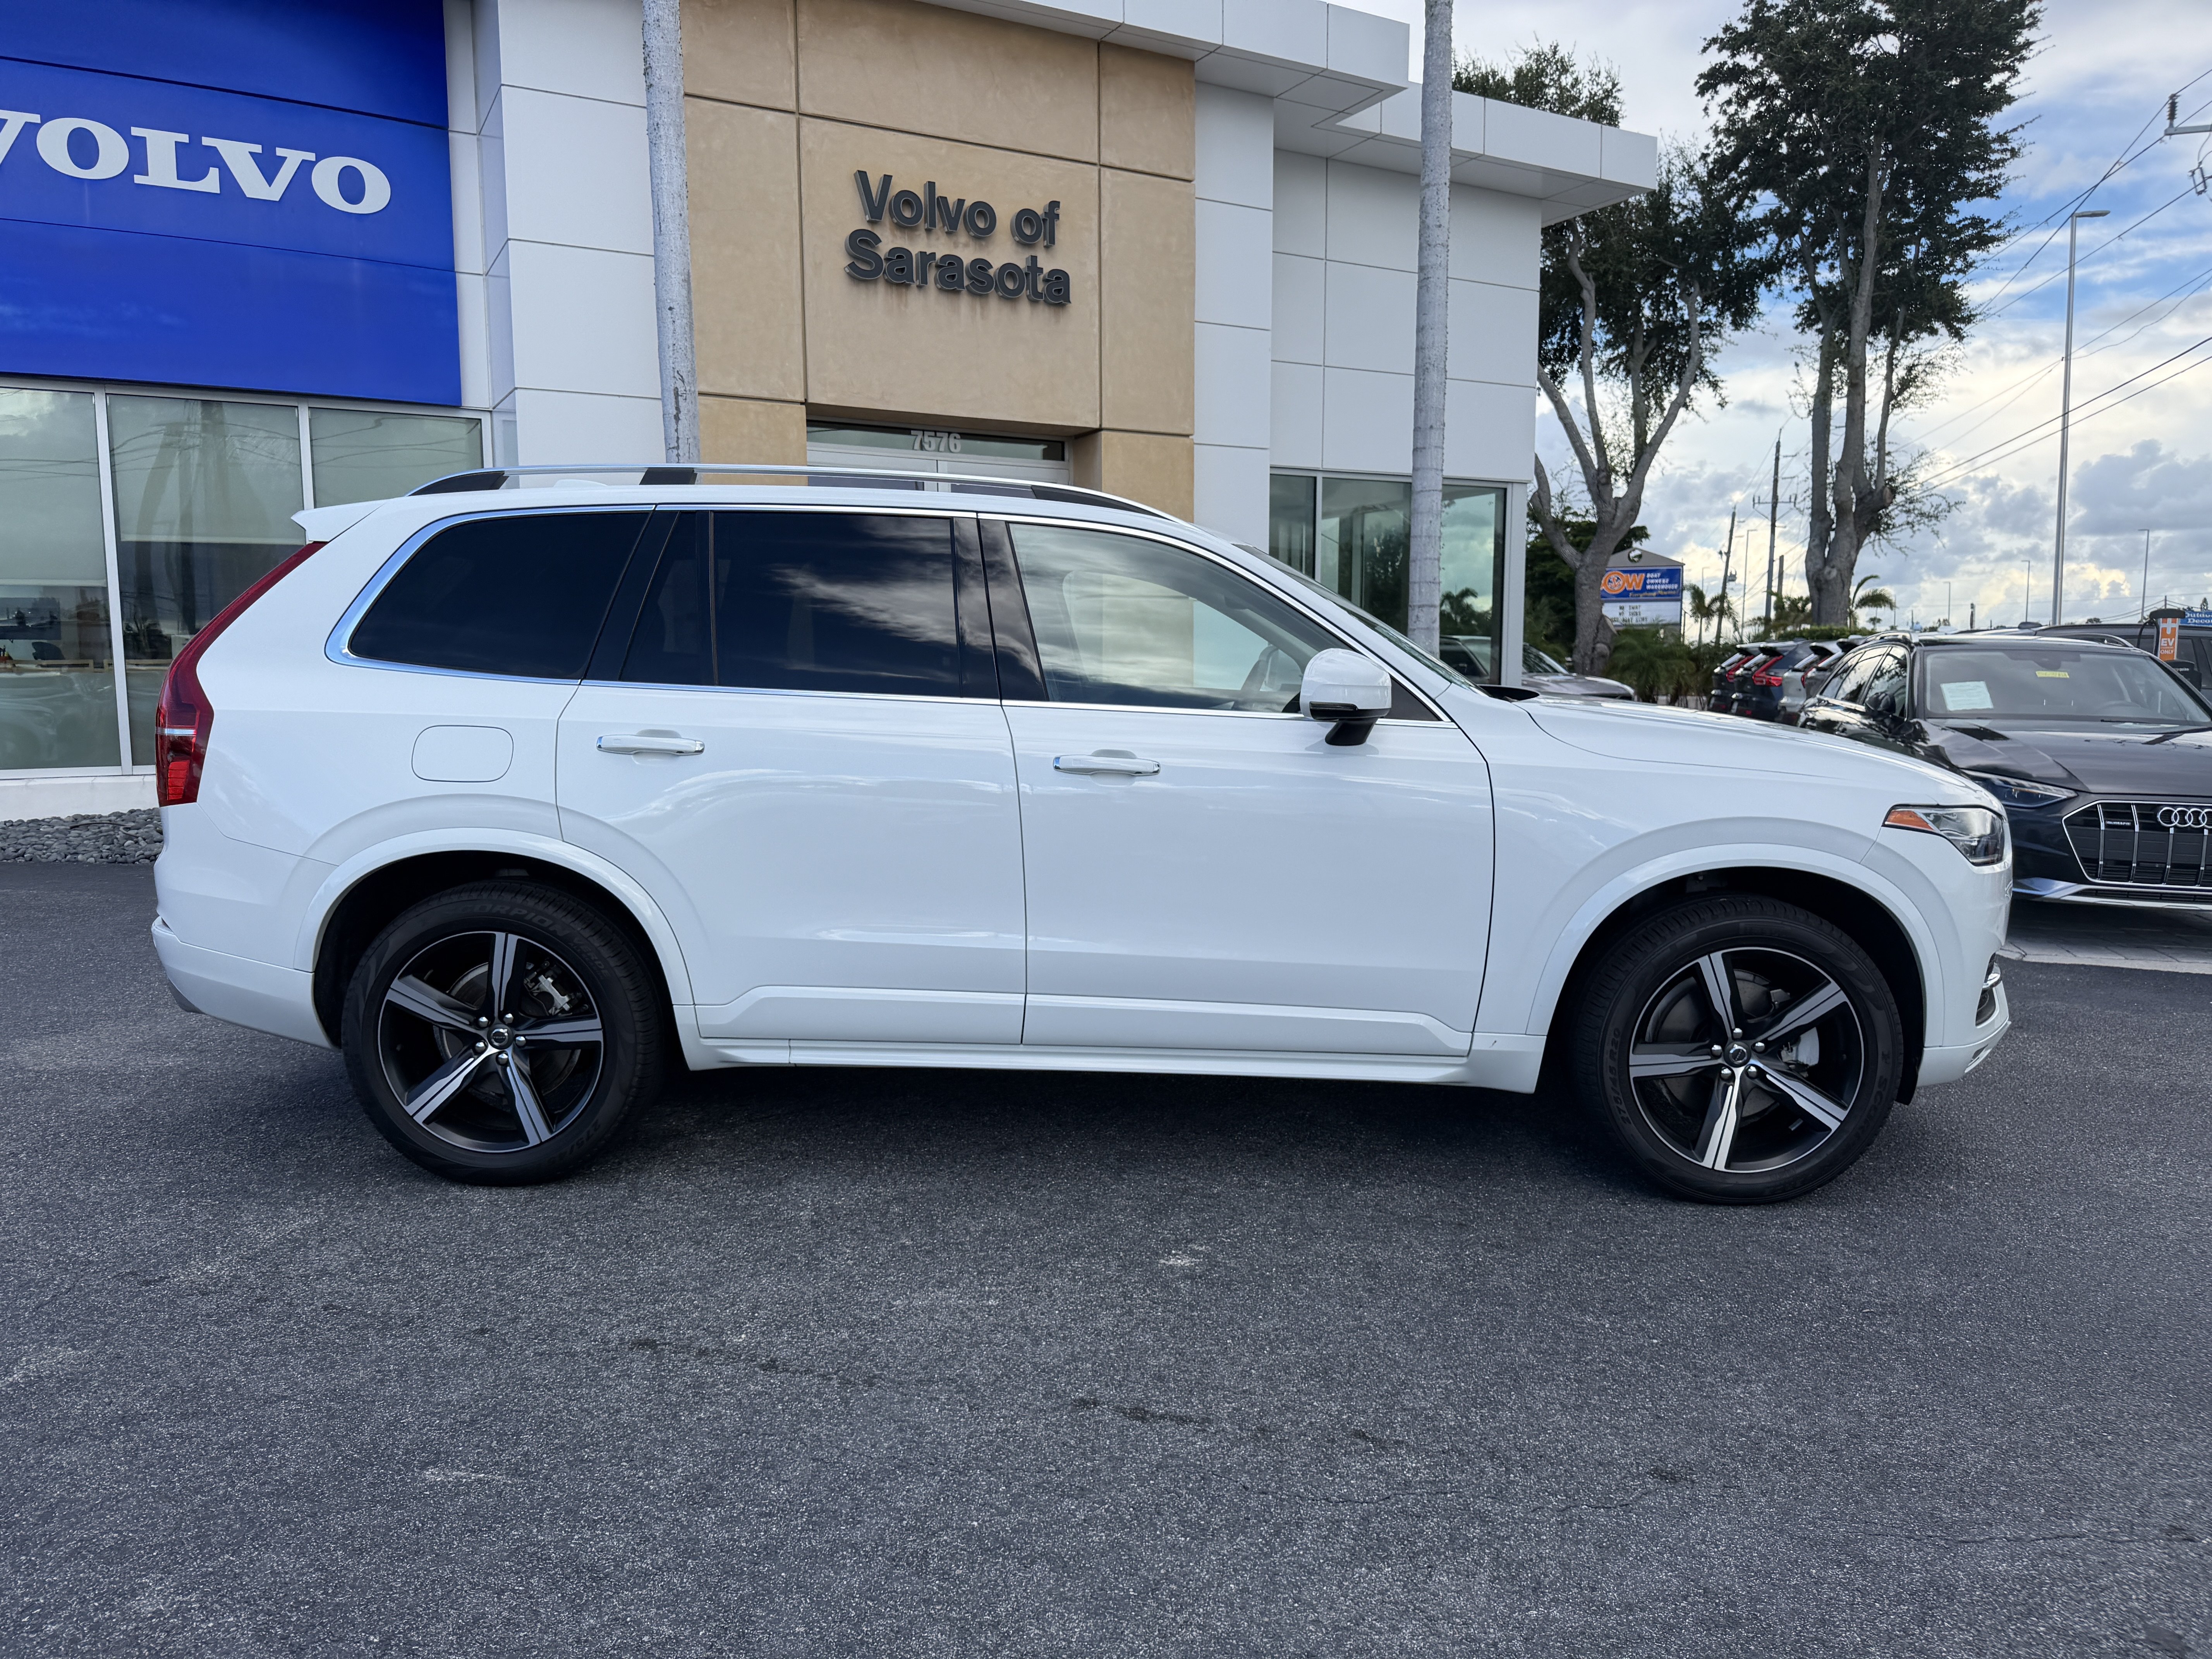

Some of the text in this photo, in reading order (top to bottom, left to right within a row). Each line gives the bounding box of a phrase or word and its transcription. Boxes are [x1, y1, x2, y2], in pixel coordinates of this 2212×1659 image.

[854, 170, 1061, 247] Volvo of
[843, 229, 1072, 305] Sarasota
[911, 430, 961, 453] 7576
[1600, 571, 1645, 594] OW
[2161, 638, 2175, 646] EV
[573, 936, 611, 977] VERDE
